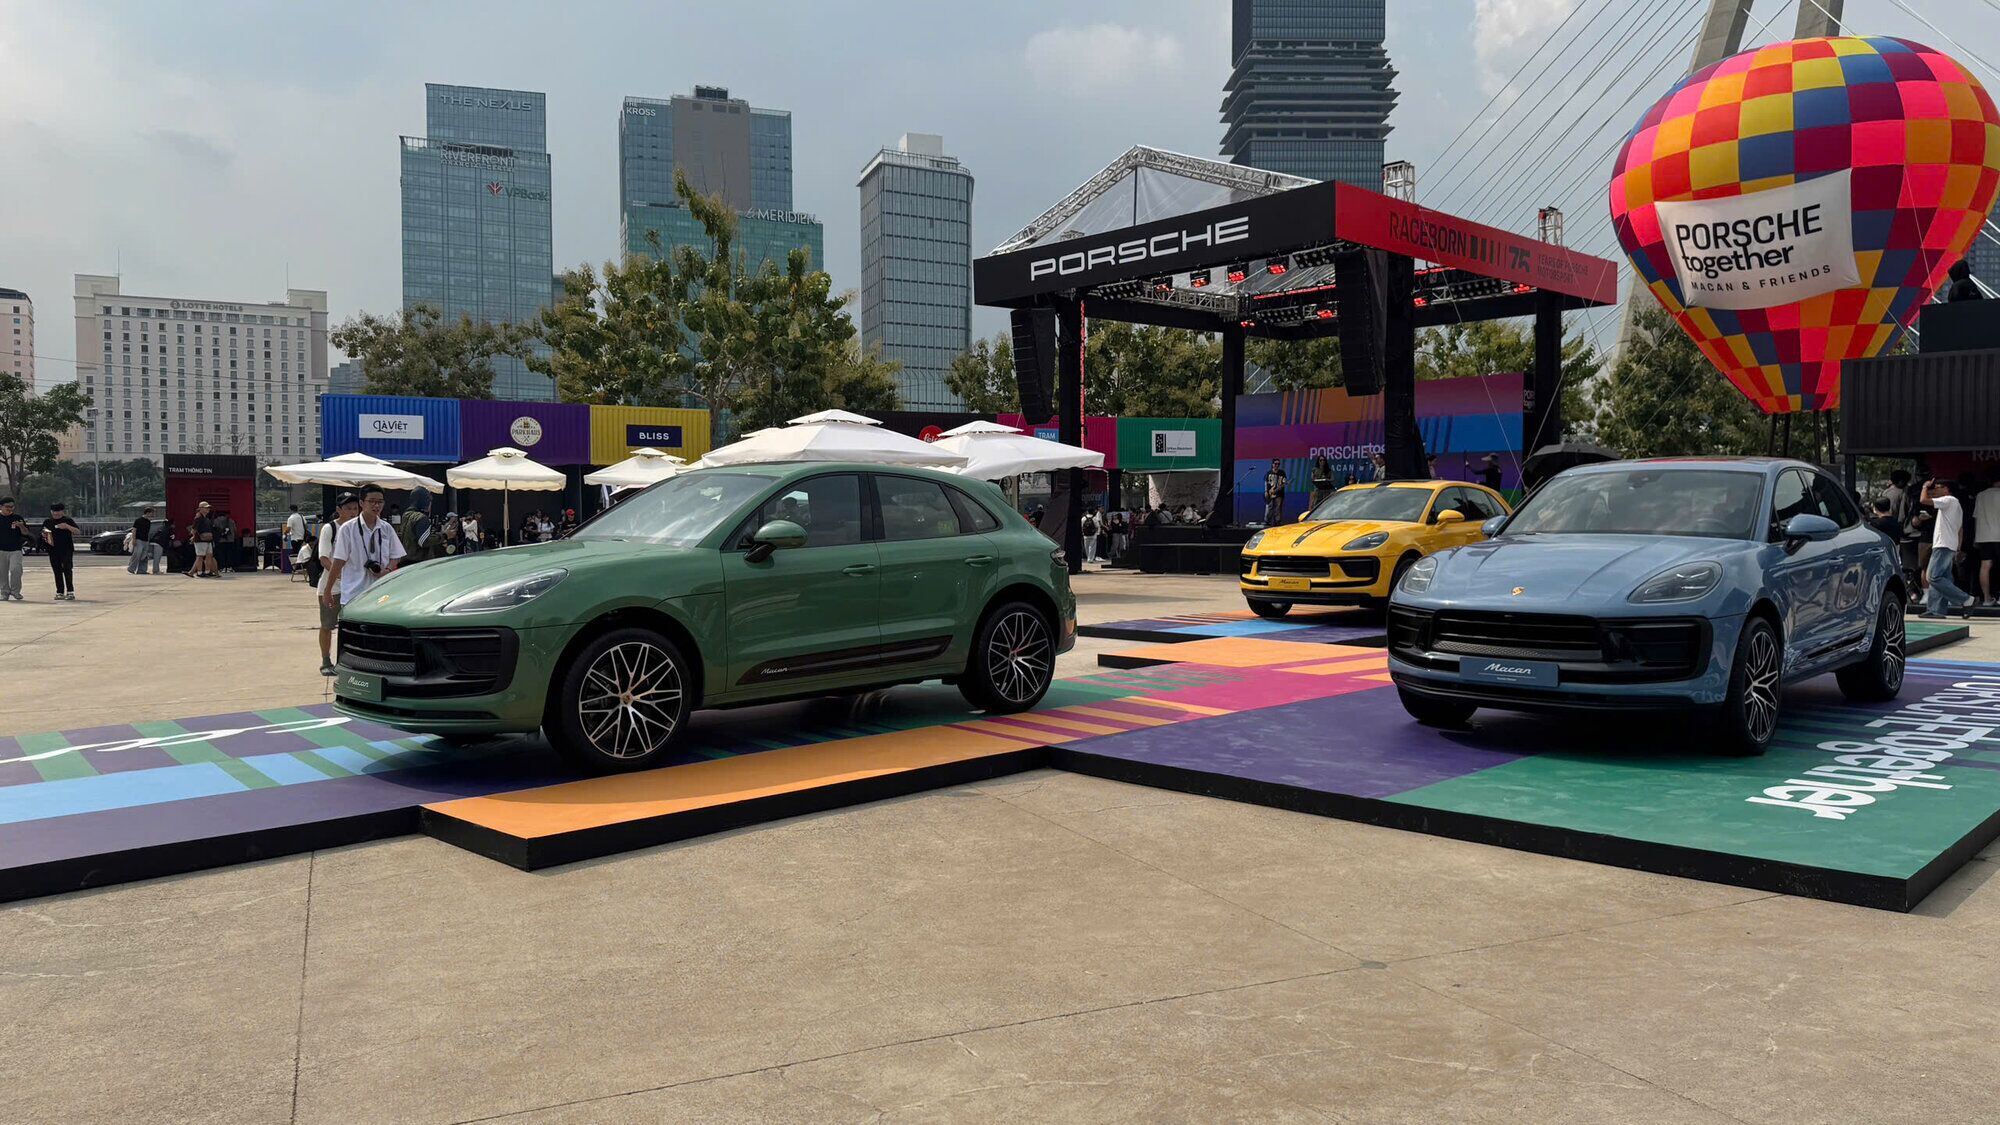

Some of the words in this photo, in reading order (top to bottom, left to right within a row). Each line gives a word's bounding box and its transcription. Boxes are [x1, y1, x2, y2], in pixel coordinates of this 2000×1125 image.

[440, 95, 473, 107] THE
[477, 98, 532, 111] NEXUS
[626, 107, 656, 117] KROSS
[440, 149, 515, 168] RIVERFRONT
[505, 186, 549, 201] VPBank
[1389, 212, 1467, 257] RACEBORN
[1675, 203, 1823, 256] PORSCHE
[1030, 215, 1250, 282] PORSCHE
[1682, 244, 1794, 279] together
[1691, 281, 1734, 292] MACAN
[1742, 281, 1750, 290] &
[1759, 264, 1832, 288] FRIENDS
[182, 302, 212, 310] LOTTE
[212, 304, 243, 312] HOTELS
[639, 432, 670, 440] BLISS
[1309, 445, 1368, 460] PORSCHE
[760, 667, 788, 675] Macan
[1484, 662, 1532, 675] Macan
[347, 675, 369, 688] Macan
